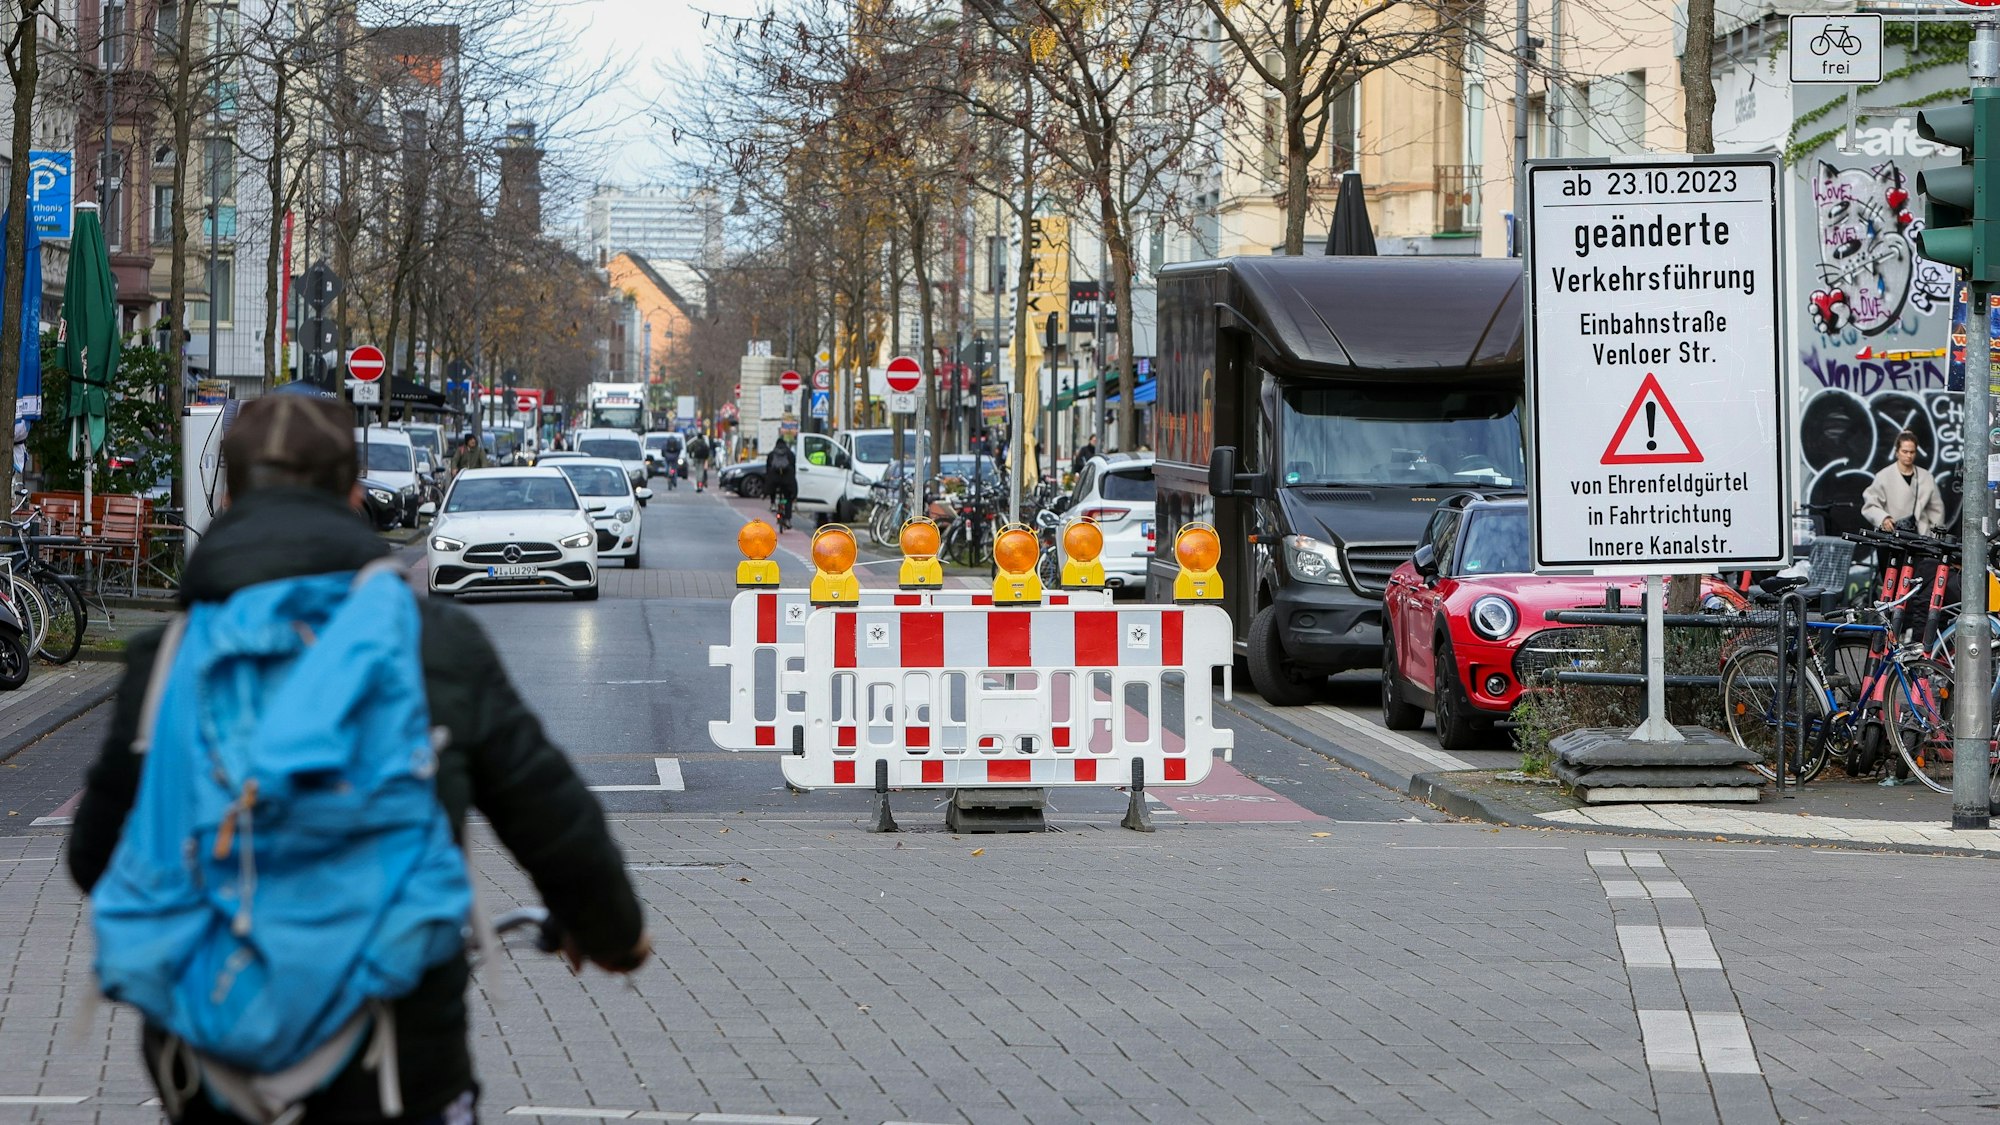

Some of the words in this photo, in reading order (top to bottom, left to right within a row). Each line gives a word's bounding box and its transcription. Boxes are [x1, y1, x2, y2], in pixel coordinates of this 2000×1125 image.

[1822, 60, 1850, 75] frei
[1562, 174, 1592, 197] ab
[1607, 169, 1738, 197] 23.10.2023
[33, 204, 63, 212] rthonia
[33, 214, 56, 222] orum
[1574, 212, 1730, 258] geänderte
[1551, 263, 1756, 296] Verkehrsführung
[1580, 310, 1727, 336] Einbahnstraße
[1592, 342, 1671, 366] Venloer
[1679, 341, 1717, 364] Str.
[1570, 480, 1602, 495] von
[1608, 471, 1749, 498] Ehrenfeldgürtel
[1588, 506, 1603, 526] in
[1609, 503, 1732, 528] Fahrtrichtung
[1588, 536, 1645, 557] Innere
[1649, 534, 1734, 557] Kanalstr.
